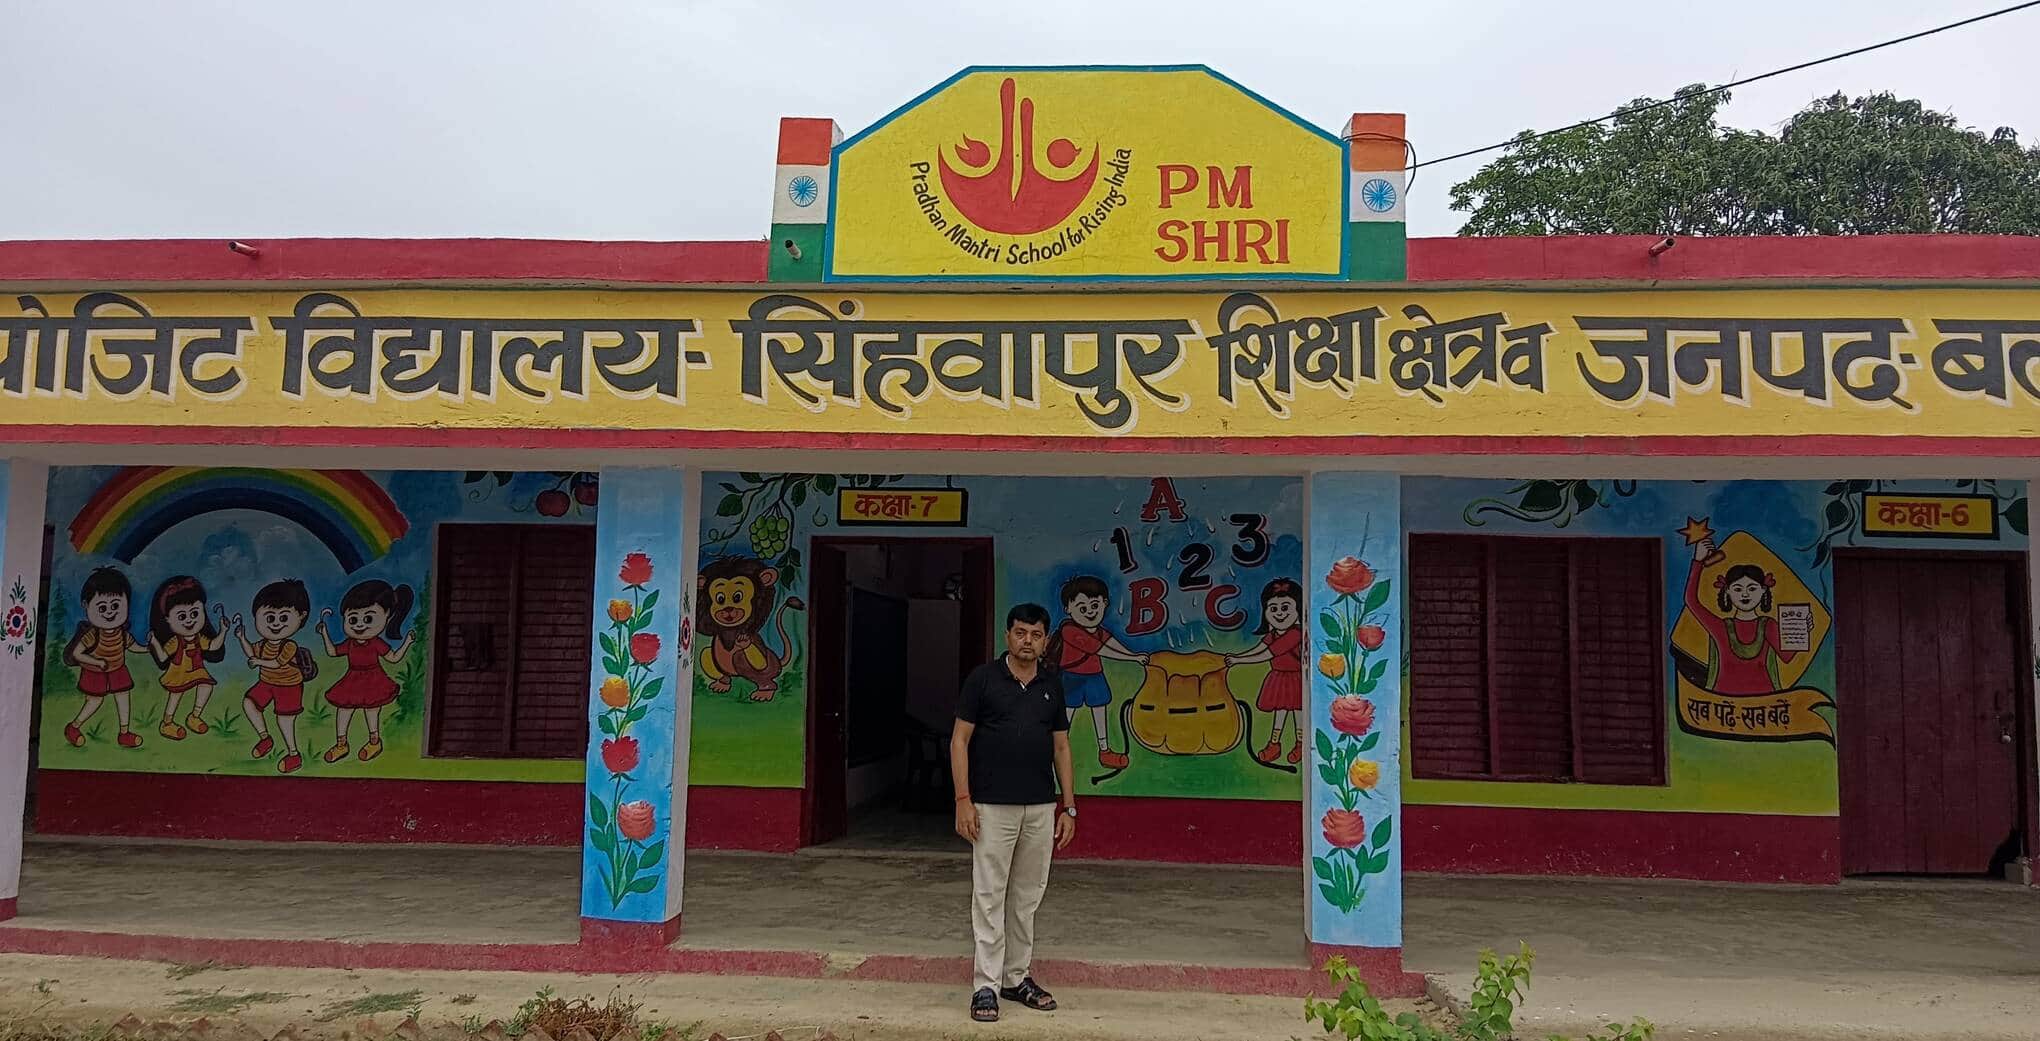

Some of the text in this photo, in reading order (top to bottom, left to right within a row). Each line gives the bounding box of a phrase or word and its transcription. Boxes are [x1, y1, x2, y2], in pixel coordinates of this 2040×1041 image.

[910, 148, 1132, 264] Pradhan Mantri School for Rising India
[1156, 164, 1254, 209] PM
[1154, 219, 1291, 265] SHRI
[1205, 292, 1385, 412] शिक्षा
[1141, 477, 1188, 522] A
[1110, 513, 1270, 592] 1 2 3
[1125, 576, 1247, 636] B C
[1688, 698, 1712, 725] सब
